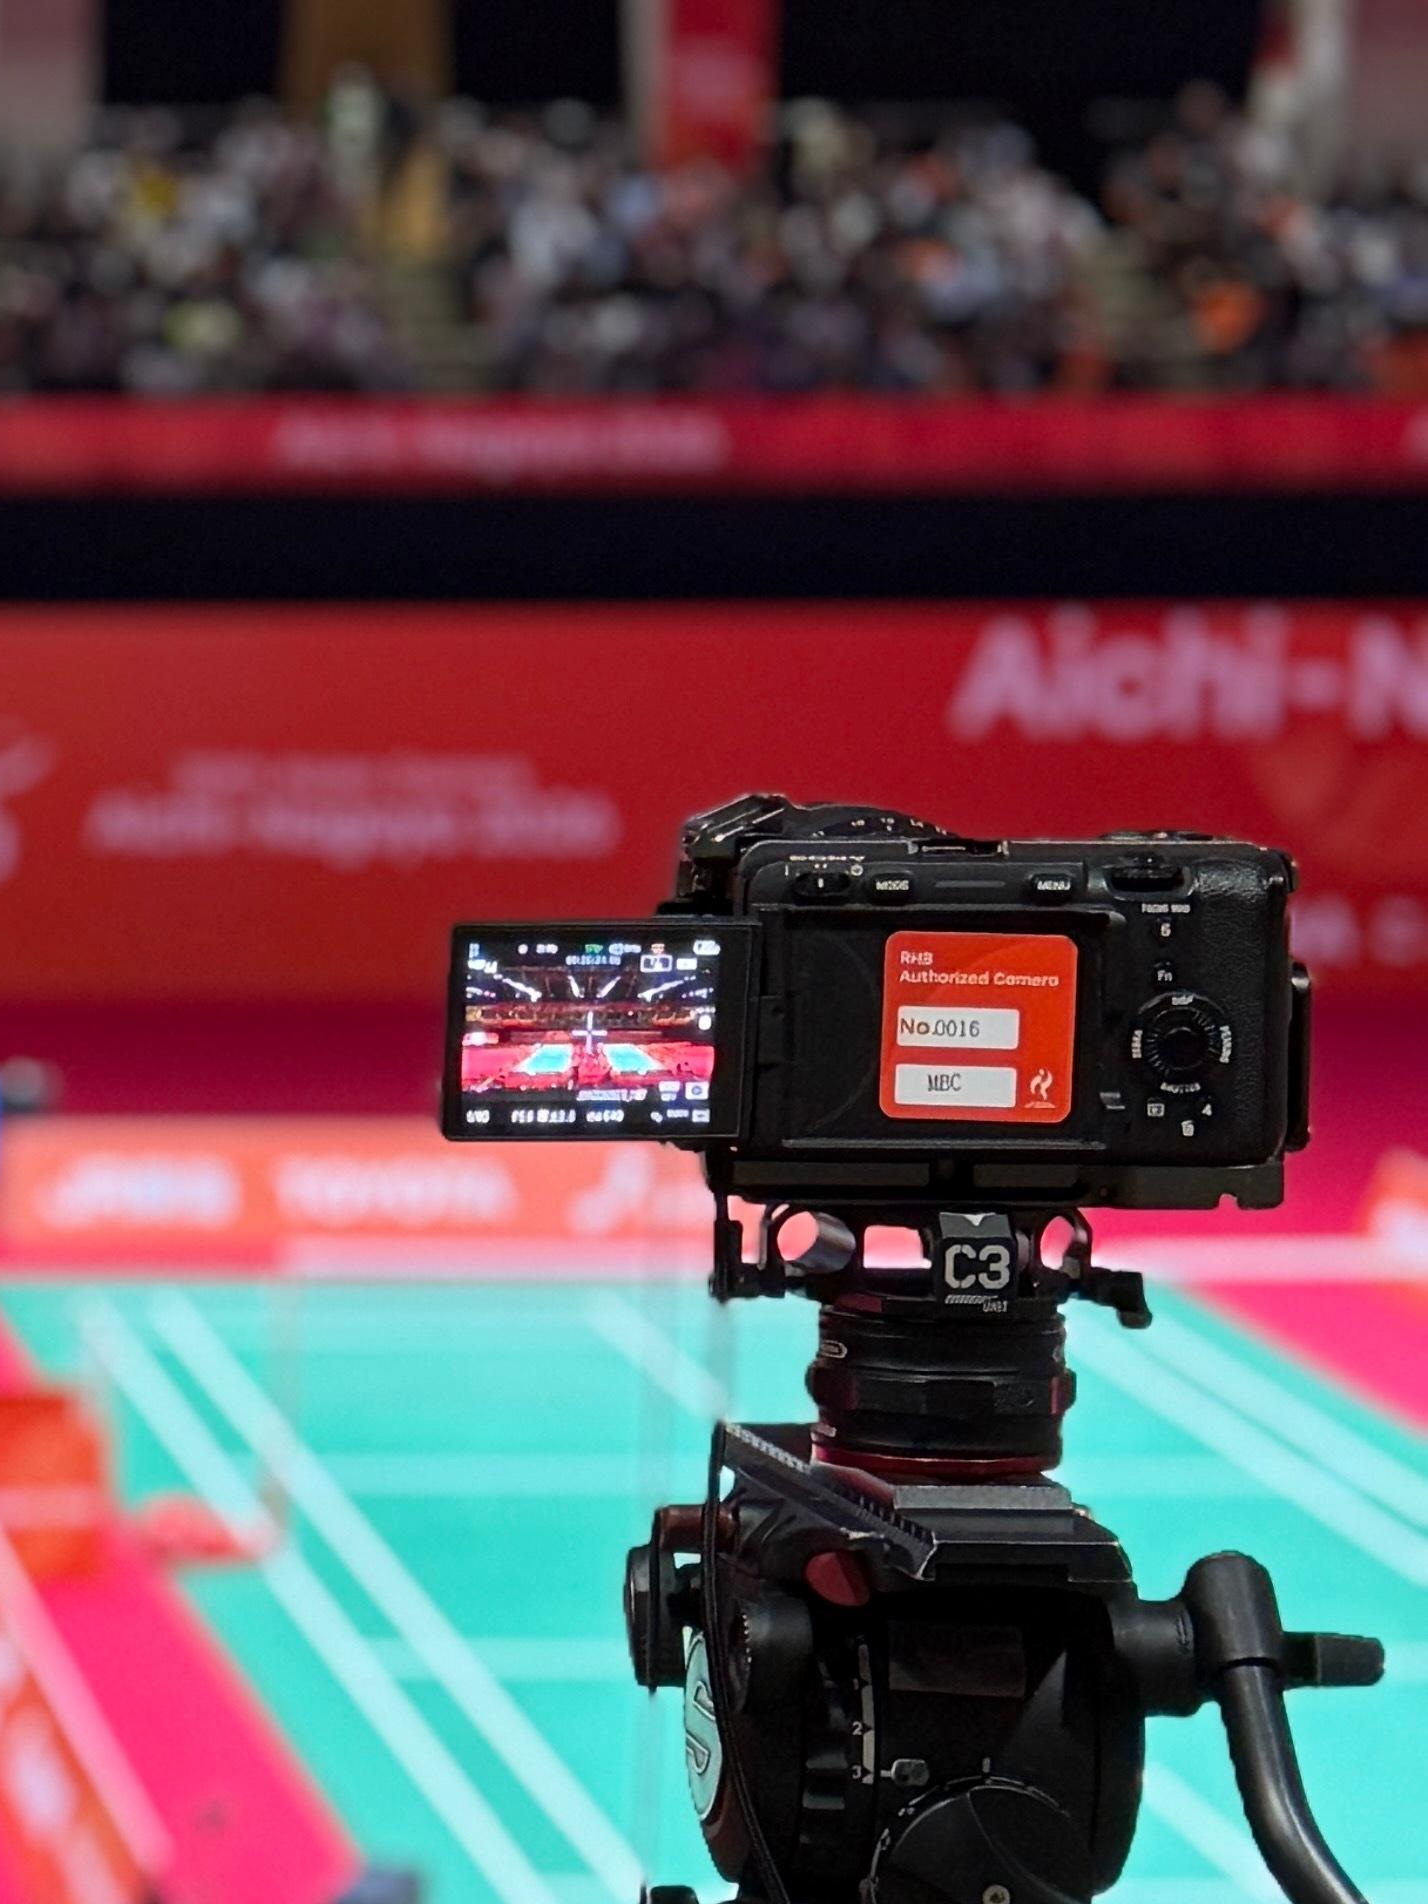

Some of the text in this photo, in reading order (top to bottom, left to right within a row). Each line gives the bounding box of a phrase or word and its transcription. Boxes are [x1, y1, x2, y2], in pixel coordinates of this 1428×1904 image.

[899, 969, 1059, 987] Authorized Camera
[1157, 970, 1173, 982] Fn
[927, 1072, 962, 1092] MBC
[945, 1244, 1010, 1289] C3
[852, 1721, 863, 1735] 2
[851, 1765, 862, 1779] 3
